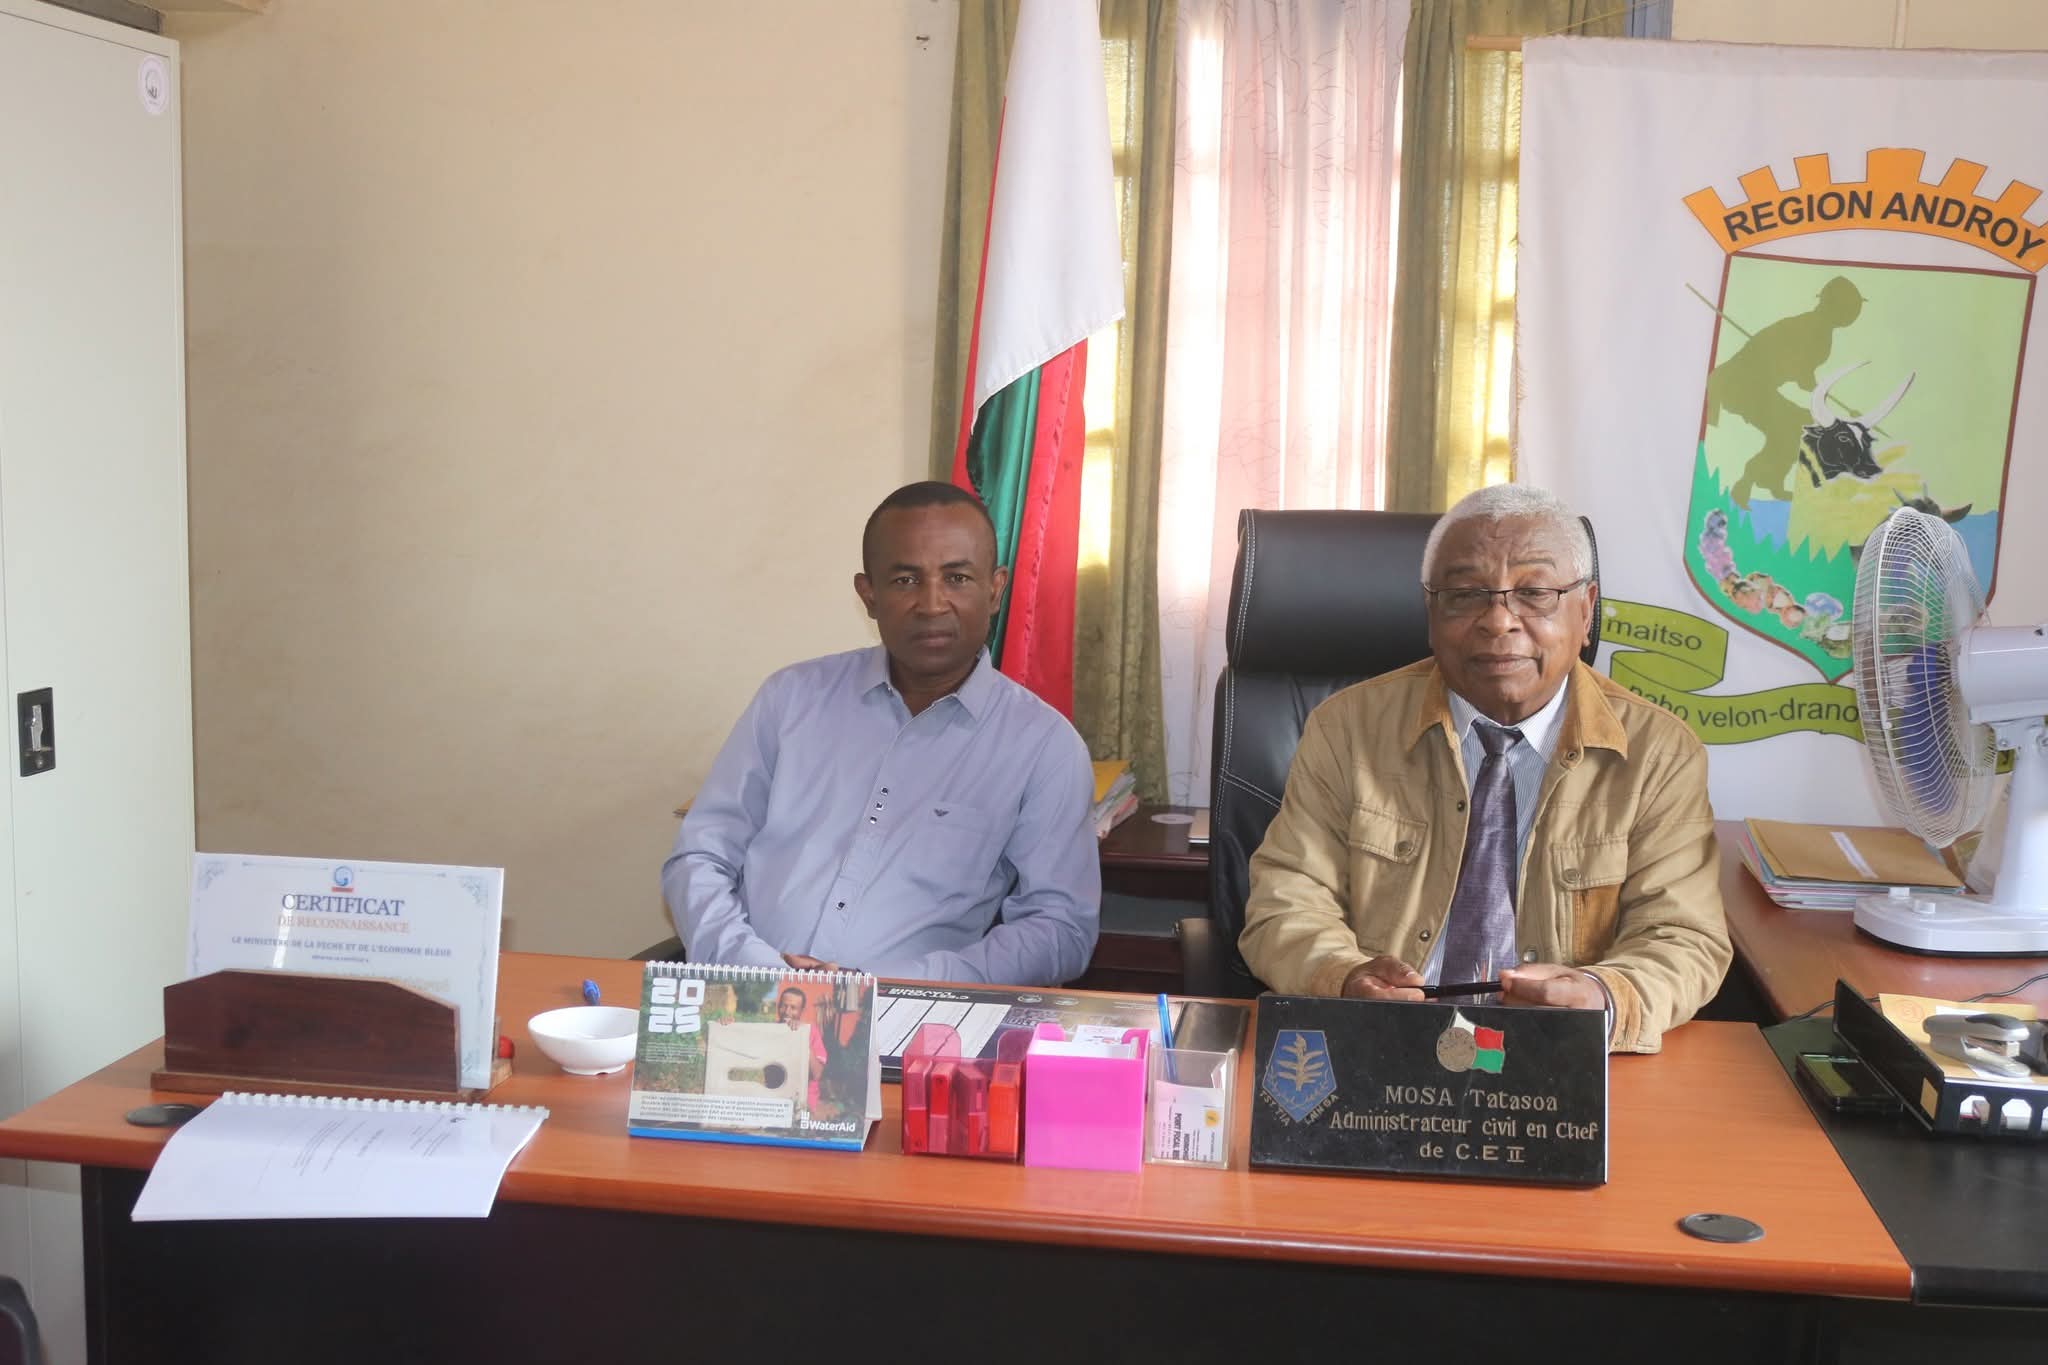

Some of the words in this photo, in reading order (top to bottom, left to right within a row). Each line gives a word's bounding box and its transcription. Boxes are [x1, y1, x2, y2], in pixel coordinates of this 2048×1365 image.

[1722, 189, 1873, 242] REGION
[1880, 192, 2046, 259] ANDROY
[1606, 618, 1702, 650] maitso
[281, 893, 405, 916] CERTIFICAT
[298, 915, 410, 934] RECONNAISSANCE
[1385, 1084, 1454, 1106] MOSA
[1468, 1089, 1559, 1112] Tatasoa
[810, 1120, 856, 1132] WaterAid
[1328, 1110, 1472, 1134] Administrateur
[1482, 1116, 1516, 1137] civil
[1526, 1121, 1547, 1139] en
[1556, 1121, 1599, 1141] Chef
[1419, 1143, 1444, 1159] de
